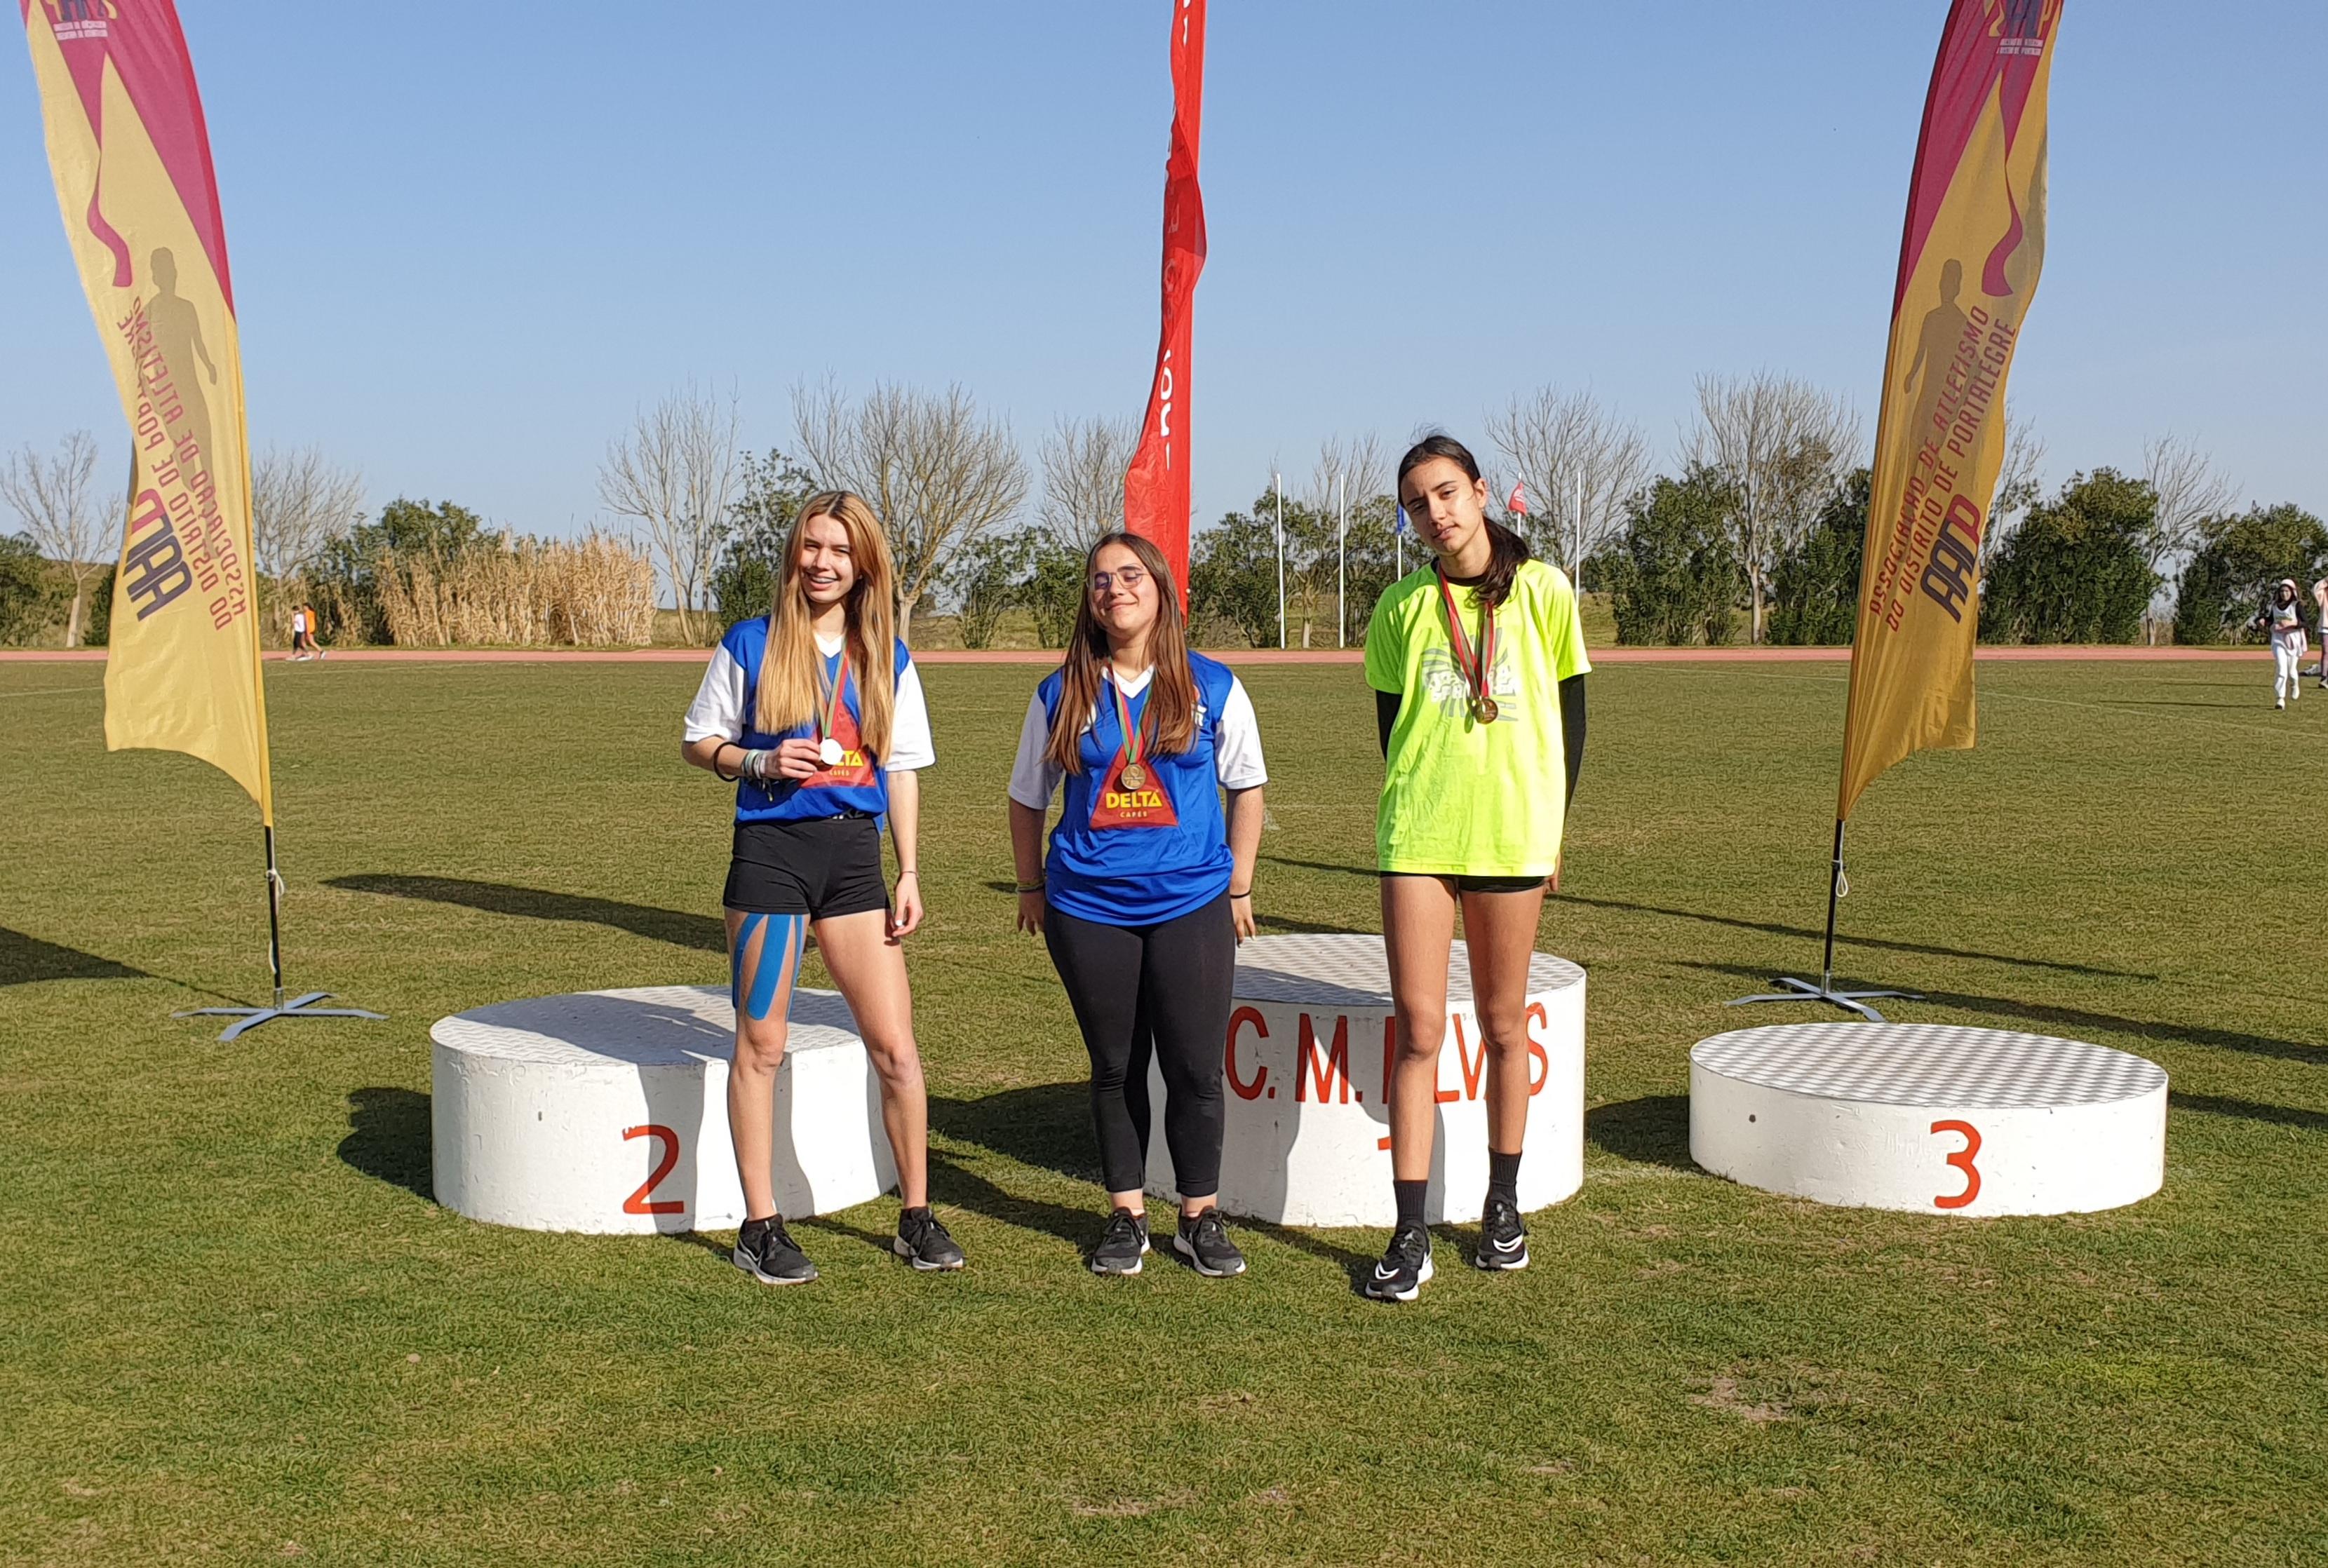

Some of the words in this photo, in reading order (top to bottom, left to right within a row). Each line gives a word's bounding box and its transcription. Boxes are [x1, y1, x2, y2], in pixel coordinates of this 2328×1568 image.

[1918, 435, 1940, 469] DE
[1932, 305, 1989, 432] ATLETISMO
[1885, 598, 1904, 632] DO
[1899, 497, 1943, 595] DISTRITO
[1933, 460, 1958, 494] DE
[1946, 318, 2017, 458] PORTALEGRE
[1105, 791, 1162, 809] DELTA
[622, 1124, 685, 1215] 2
[1930, 1120, 1982, 1209] 3
